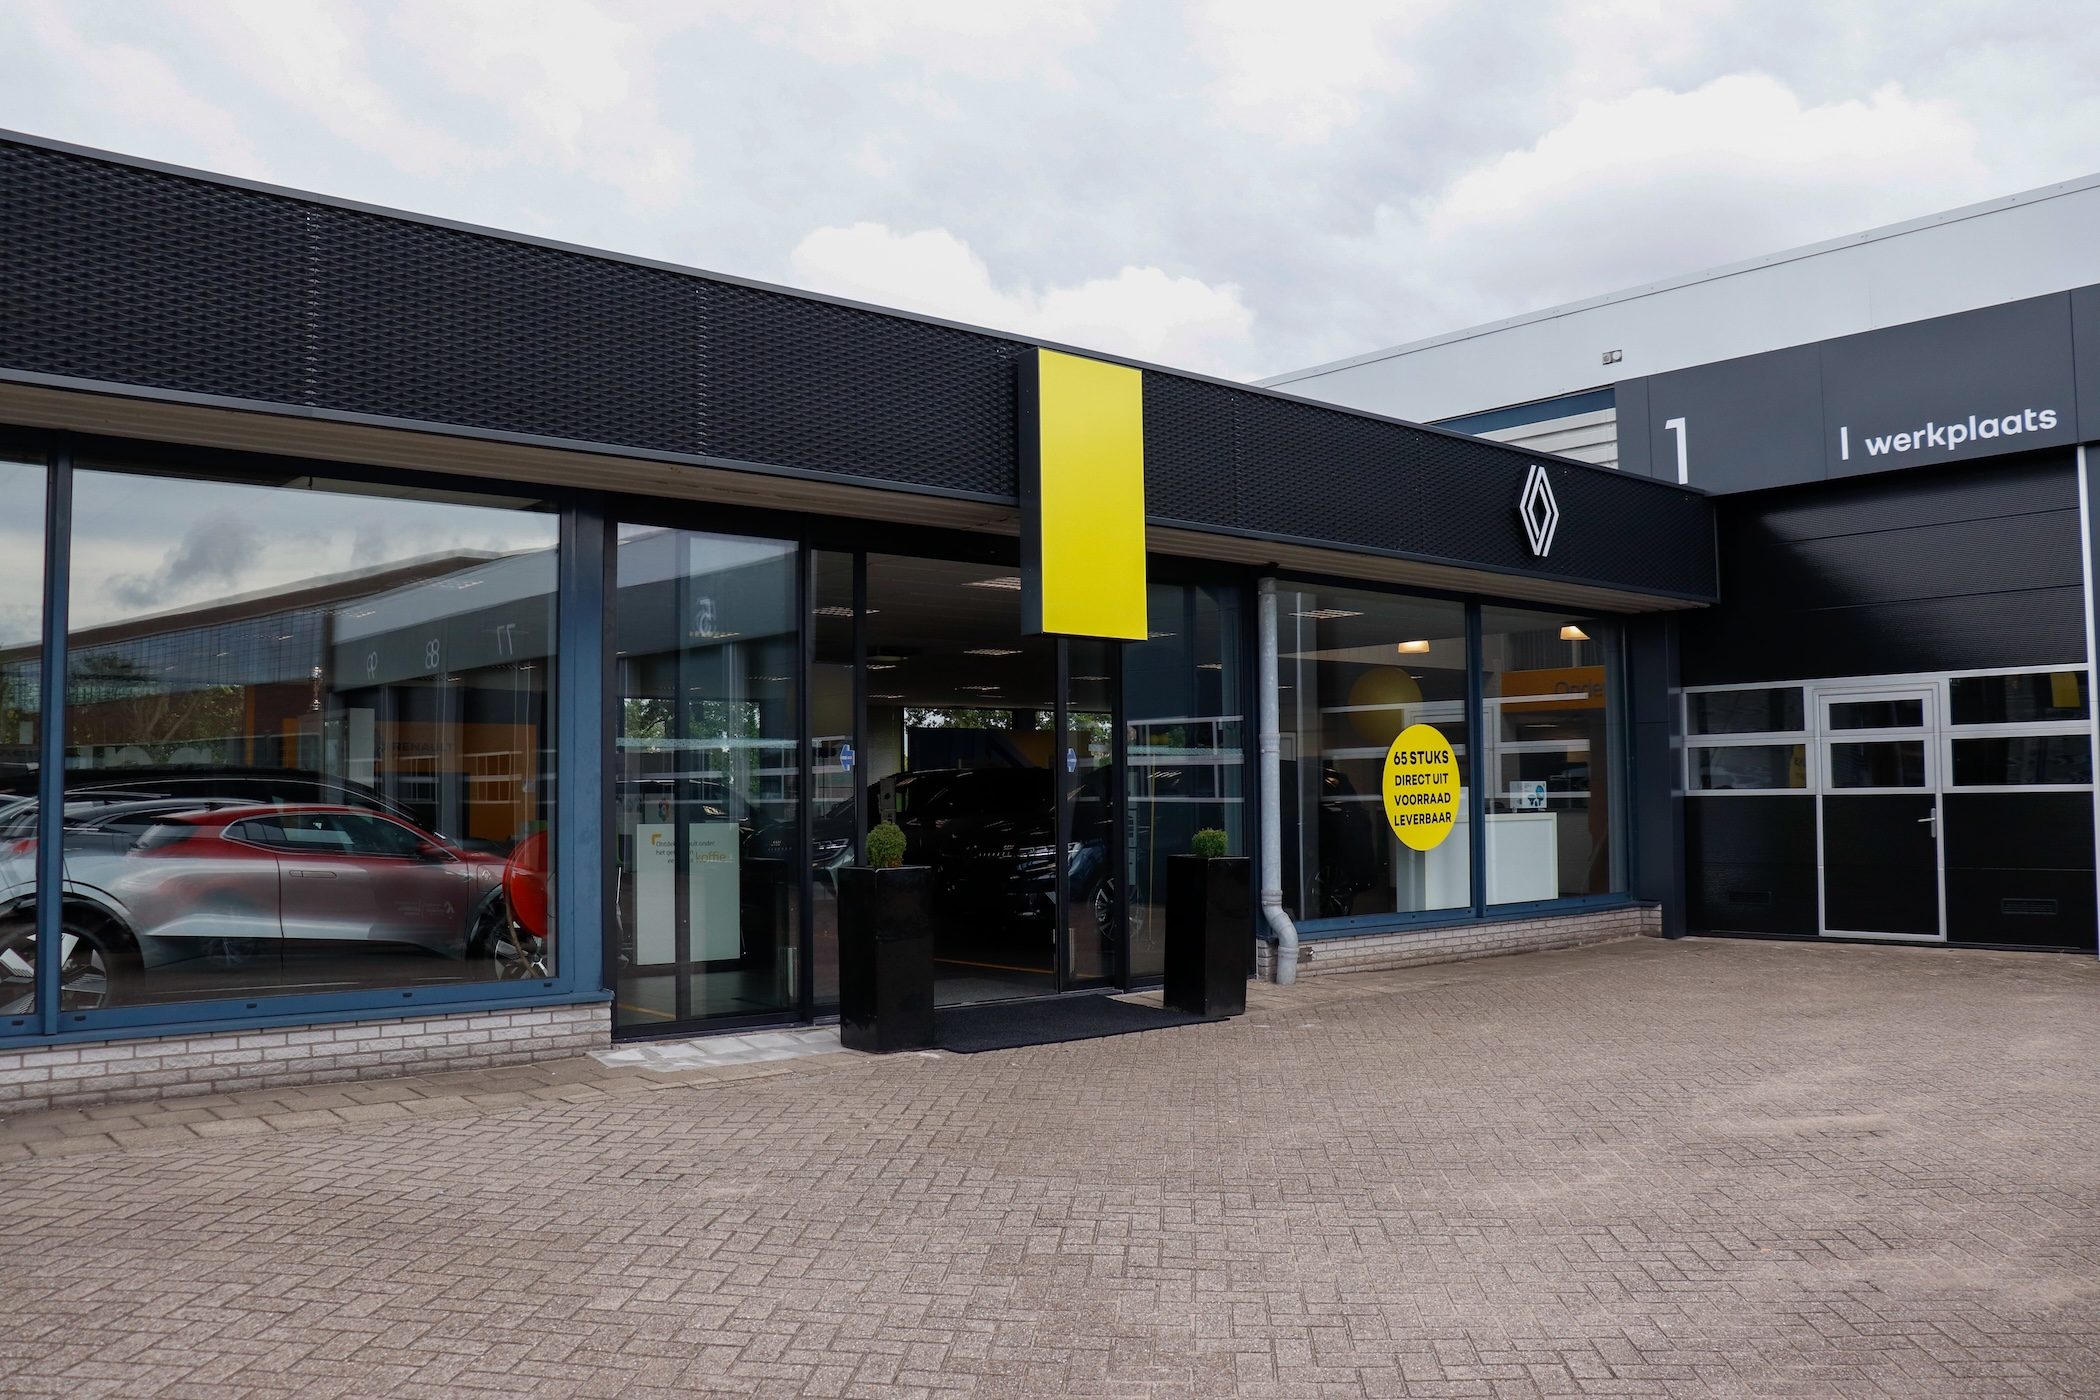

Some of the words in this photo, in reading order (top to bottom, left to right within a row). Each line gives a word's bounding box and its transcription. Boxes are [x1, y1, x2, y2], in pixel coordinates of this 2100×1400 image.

[1864, 408, 2058, 456] werkplaats
[1664, 416, 1688, 485] 1
[1393, 751, 1408, 766] 65
[1410, 750, 1449, 765] STUKS
[1394, 774, 1431, 786] DIRECT
[1433, 773, 1449, 784] UIT
[1394, 793, 1451, 806] VOORRAAD
[1394, 812, 1452, 826] LEVERBAAR
